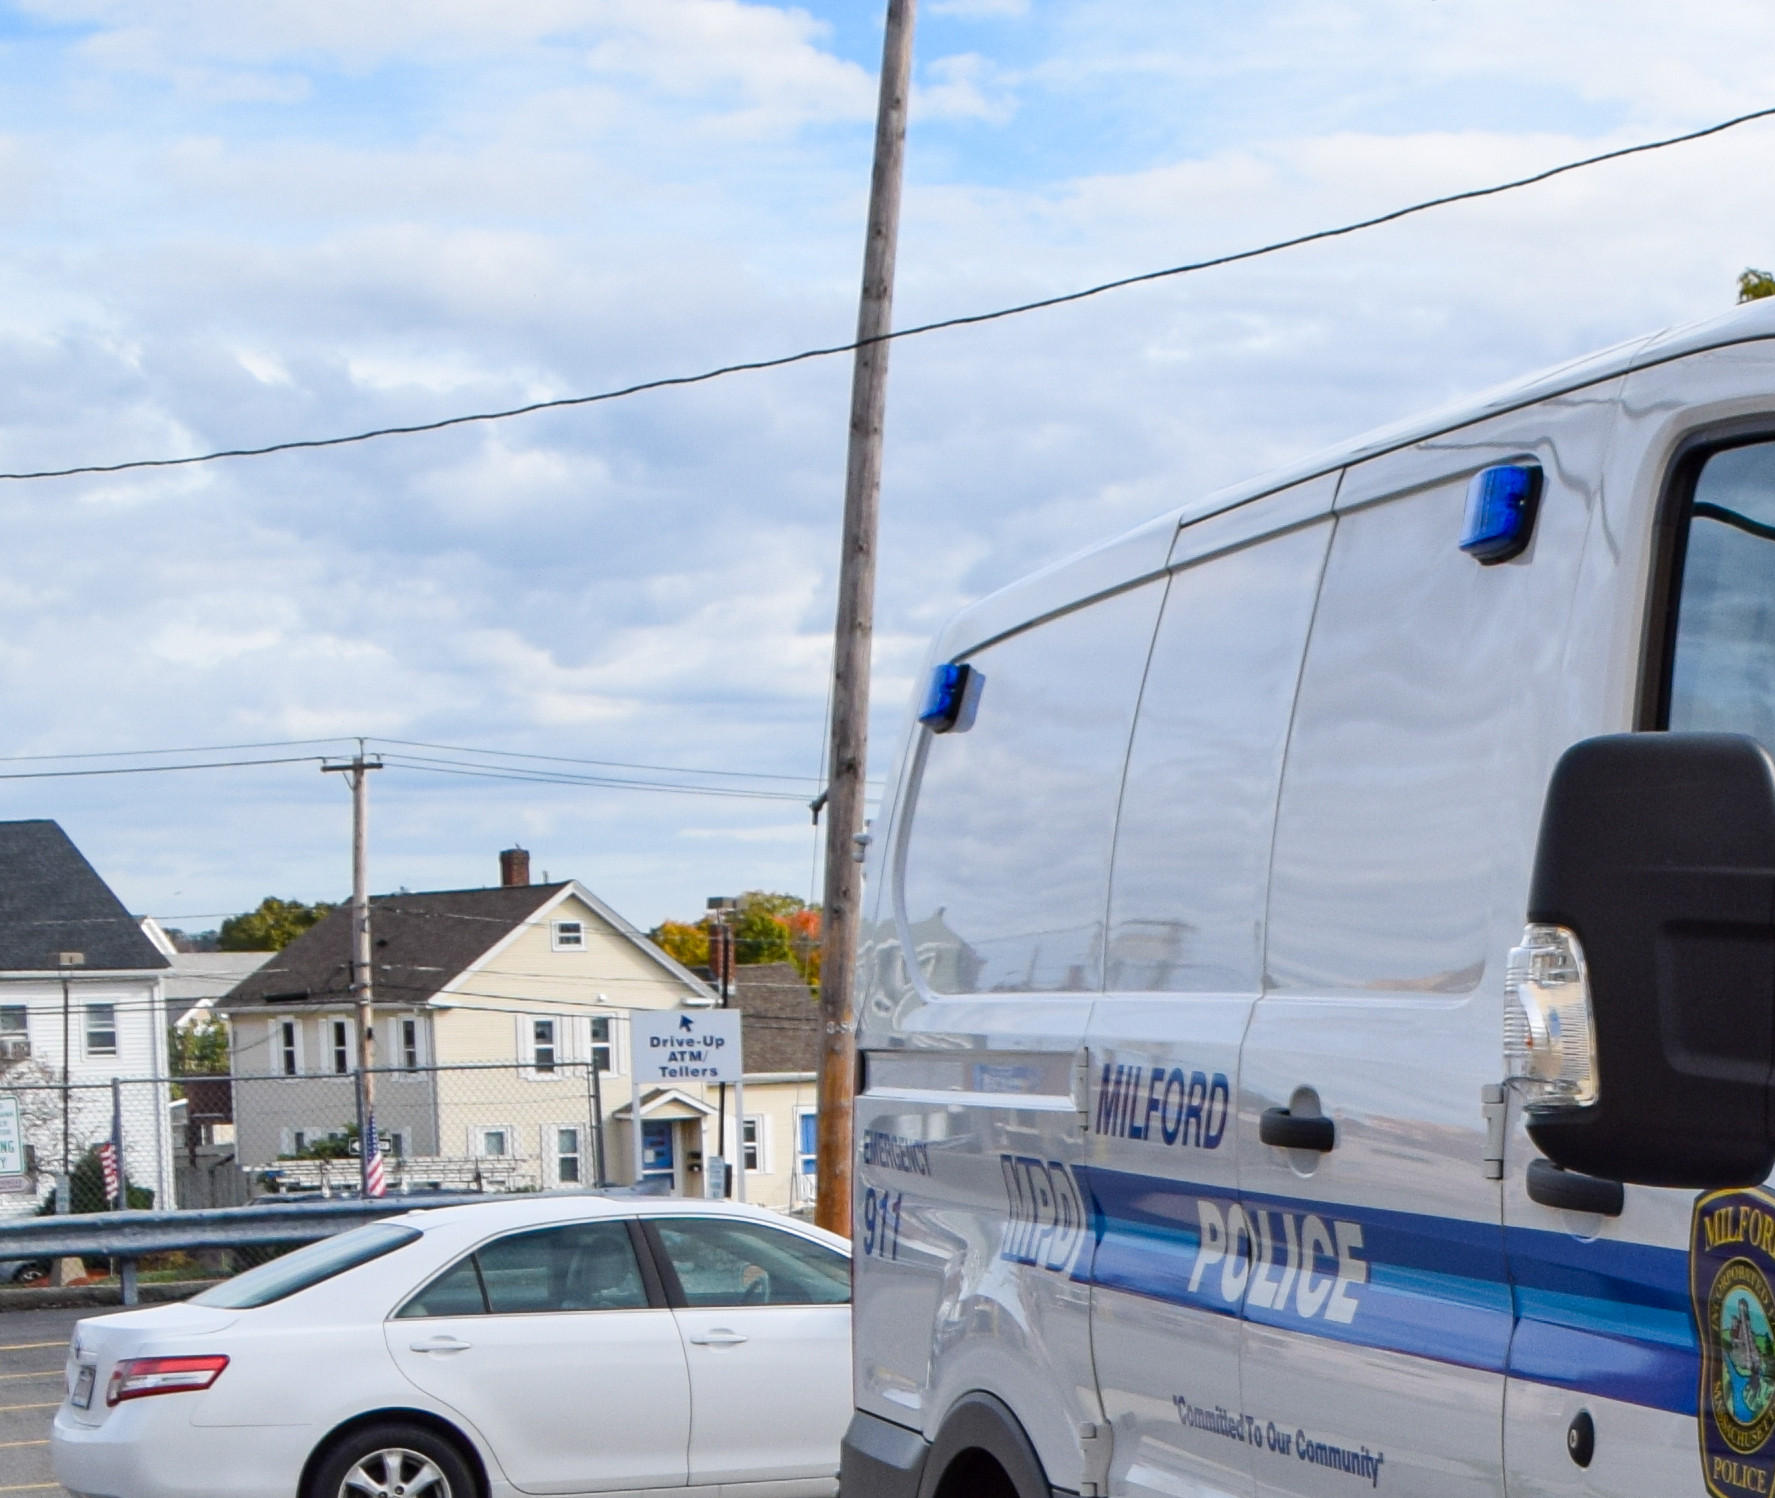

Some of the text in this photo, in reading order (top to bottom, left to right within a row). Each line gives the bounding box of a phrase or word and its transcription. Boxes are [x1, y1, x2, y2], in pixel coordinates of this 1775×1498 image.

[649, 1036, 725, 1049] Drive-Up
[659, 1066, 718, 1078] Tellers
[1095, 1063, 1229, 1149] MILFORD
[863, 1129, 932, 1177] EMERGENCY
[863, 1187, 903, 1261] 911
[1187, 1200, 1368, 1324] POLICE
[1244, 1415, 1263, 1448] To
[1266, 1421, 1292, 1455] Our
[1713, 1456, 1767, 1494] POLICE
